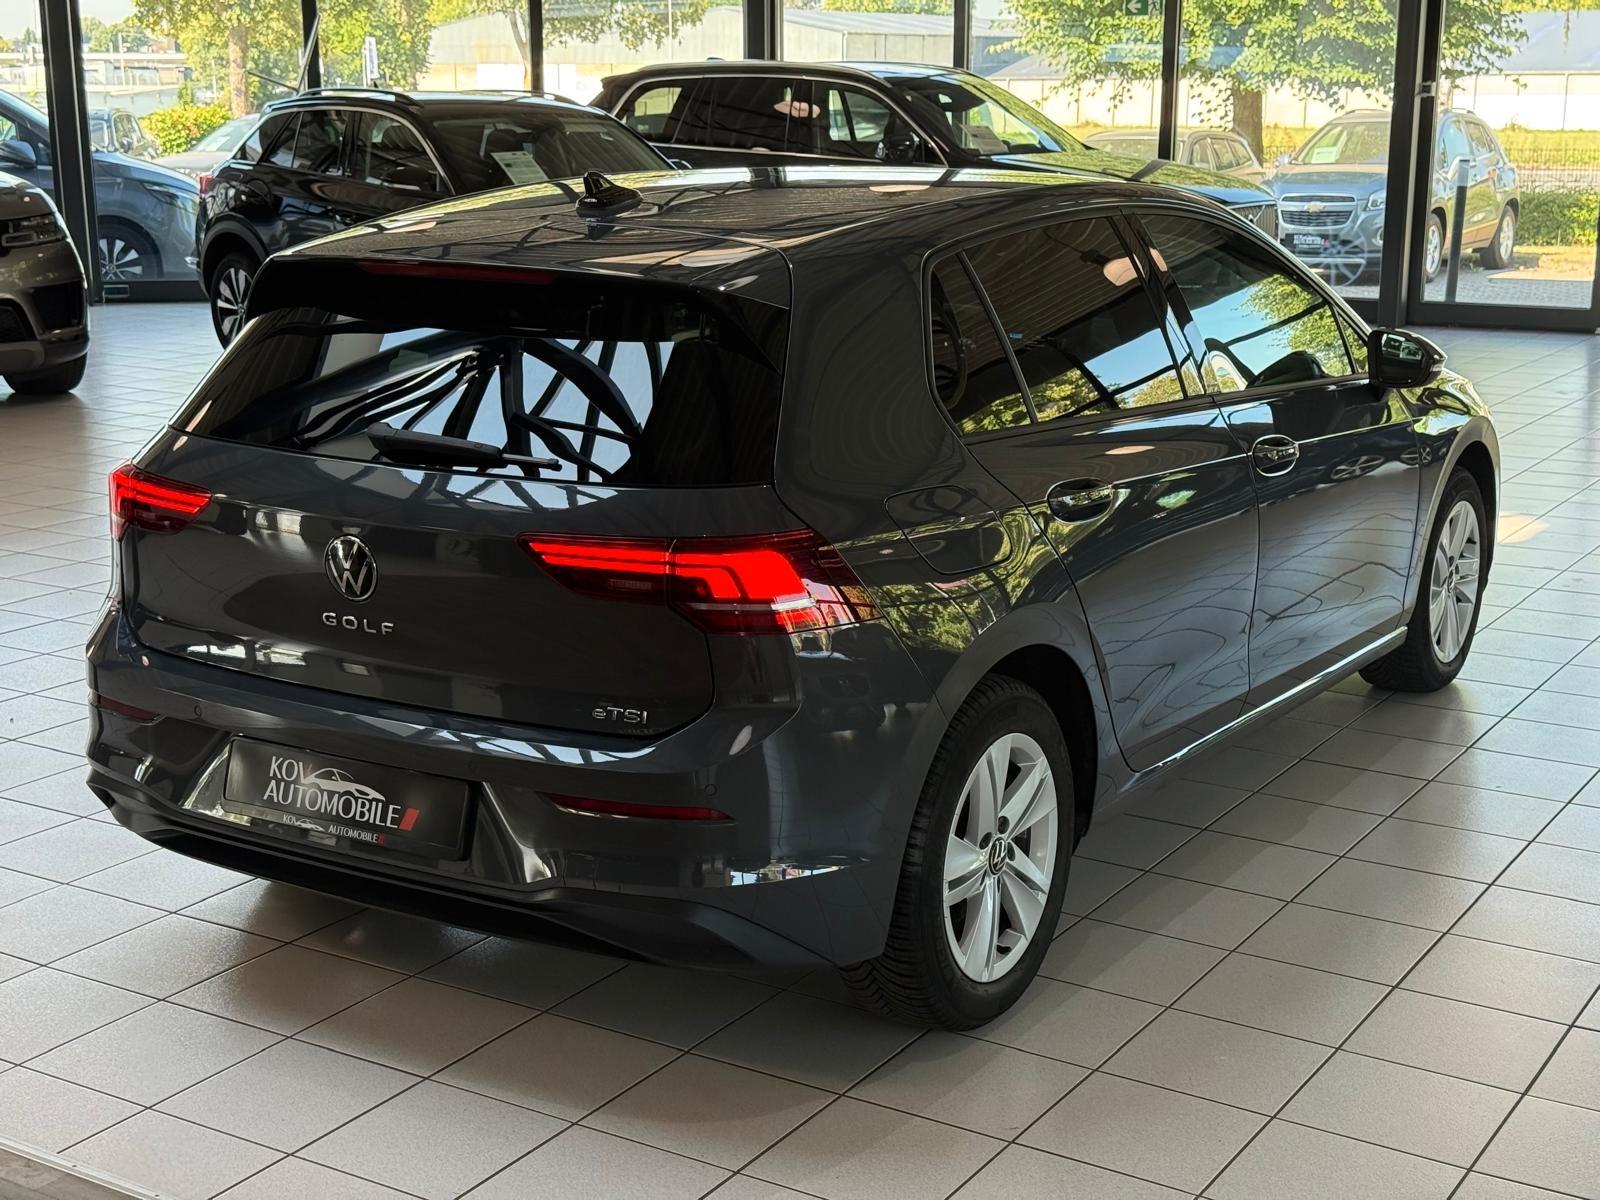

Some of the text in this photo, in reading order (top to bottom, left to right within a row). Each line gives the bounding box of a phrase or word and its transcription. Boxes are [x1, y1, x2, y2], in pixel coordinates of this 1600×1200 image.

[322, 611, 394, 636] GOLF
[591, 706, 648, 725] eTSI
[263, 779, 402, 830] AUTOMOBILE
[328, 824, 380, 843] AUTOMOBILE
